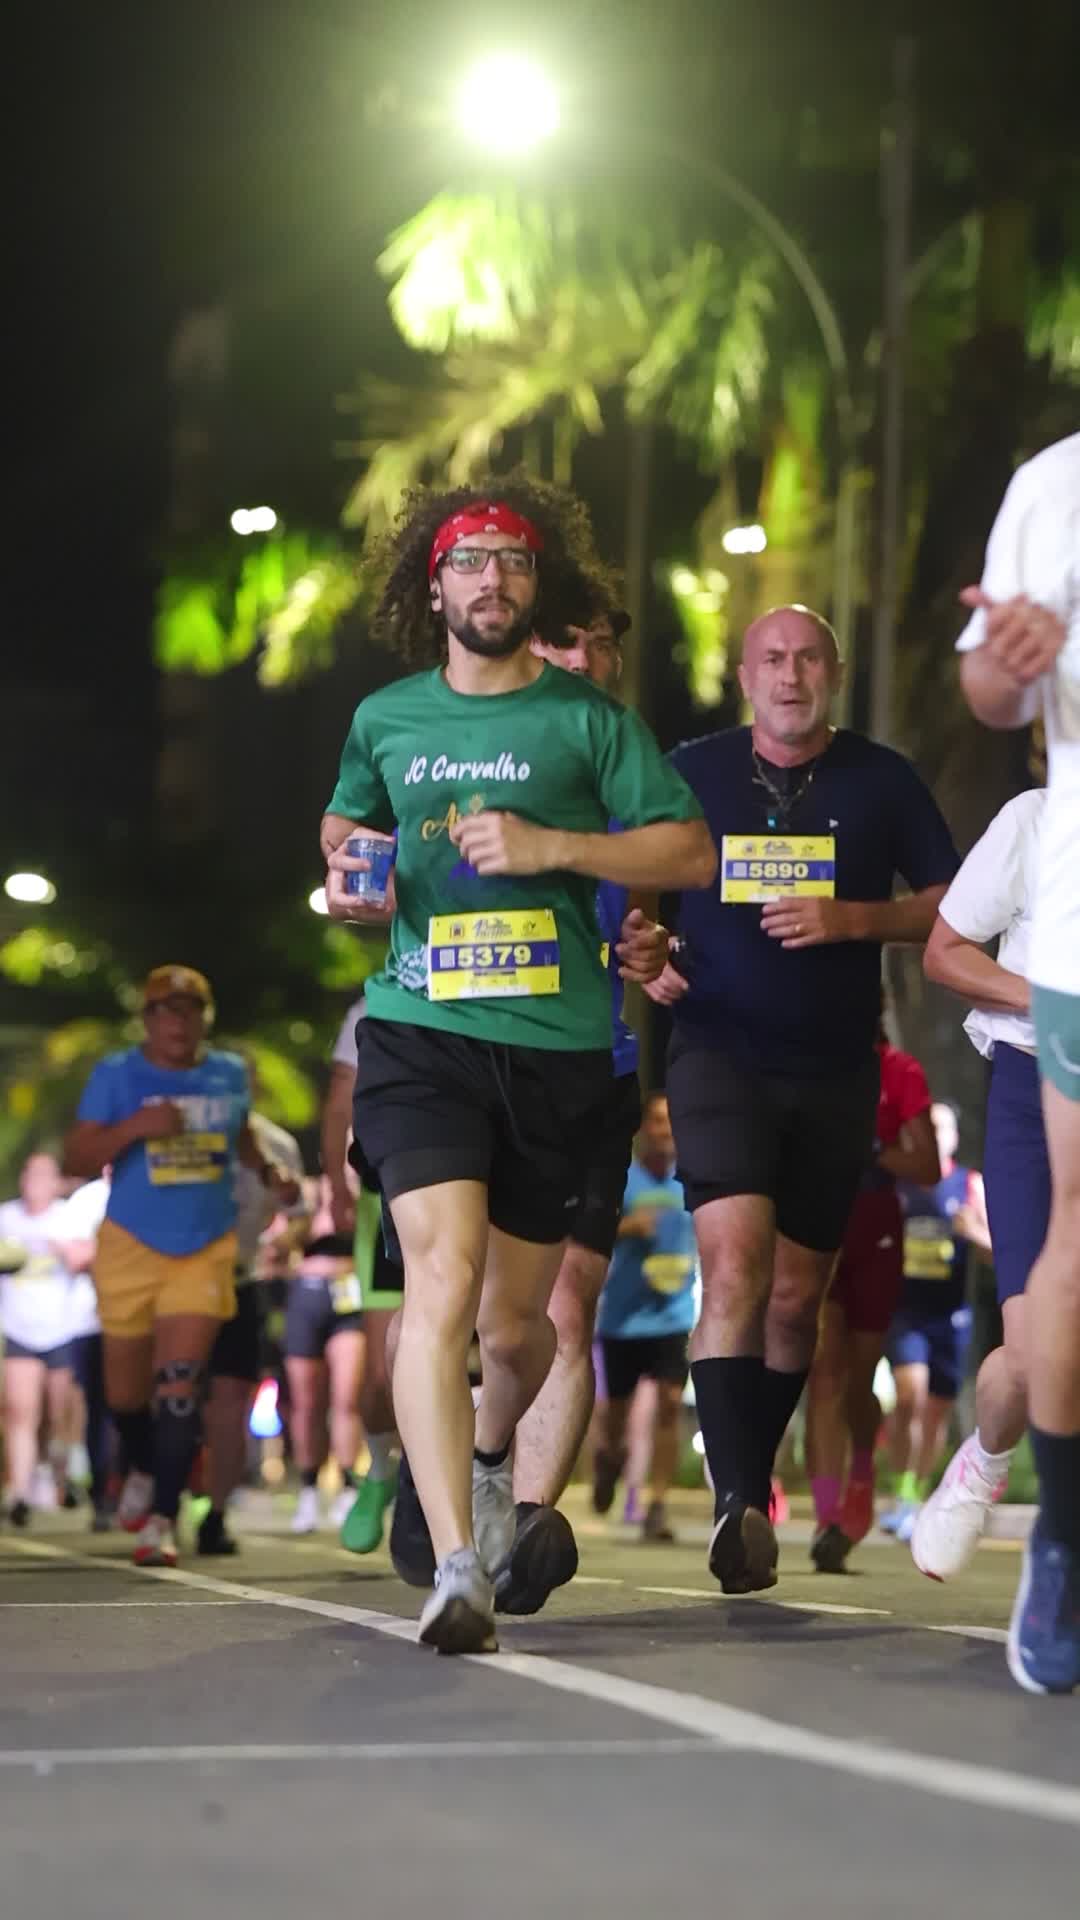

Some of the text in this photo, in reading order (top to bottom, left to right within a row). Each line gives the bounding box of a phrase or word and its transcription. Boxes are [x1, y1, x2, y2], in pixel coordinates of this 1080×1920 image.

[404, 751, 531, 786] JC Carvalho
[748, 861, 809, 879] 5890
[457, 944, 532, 968] 5379
